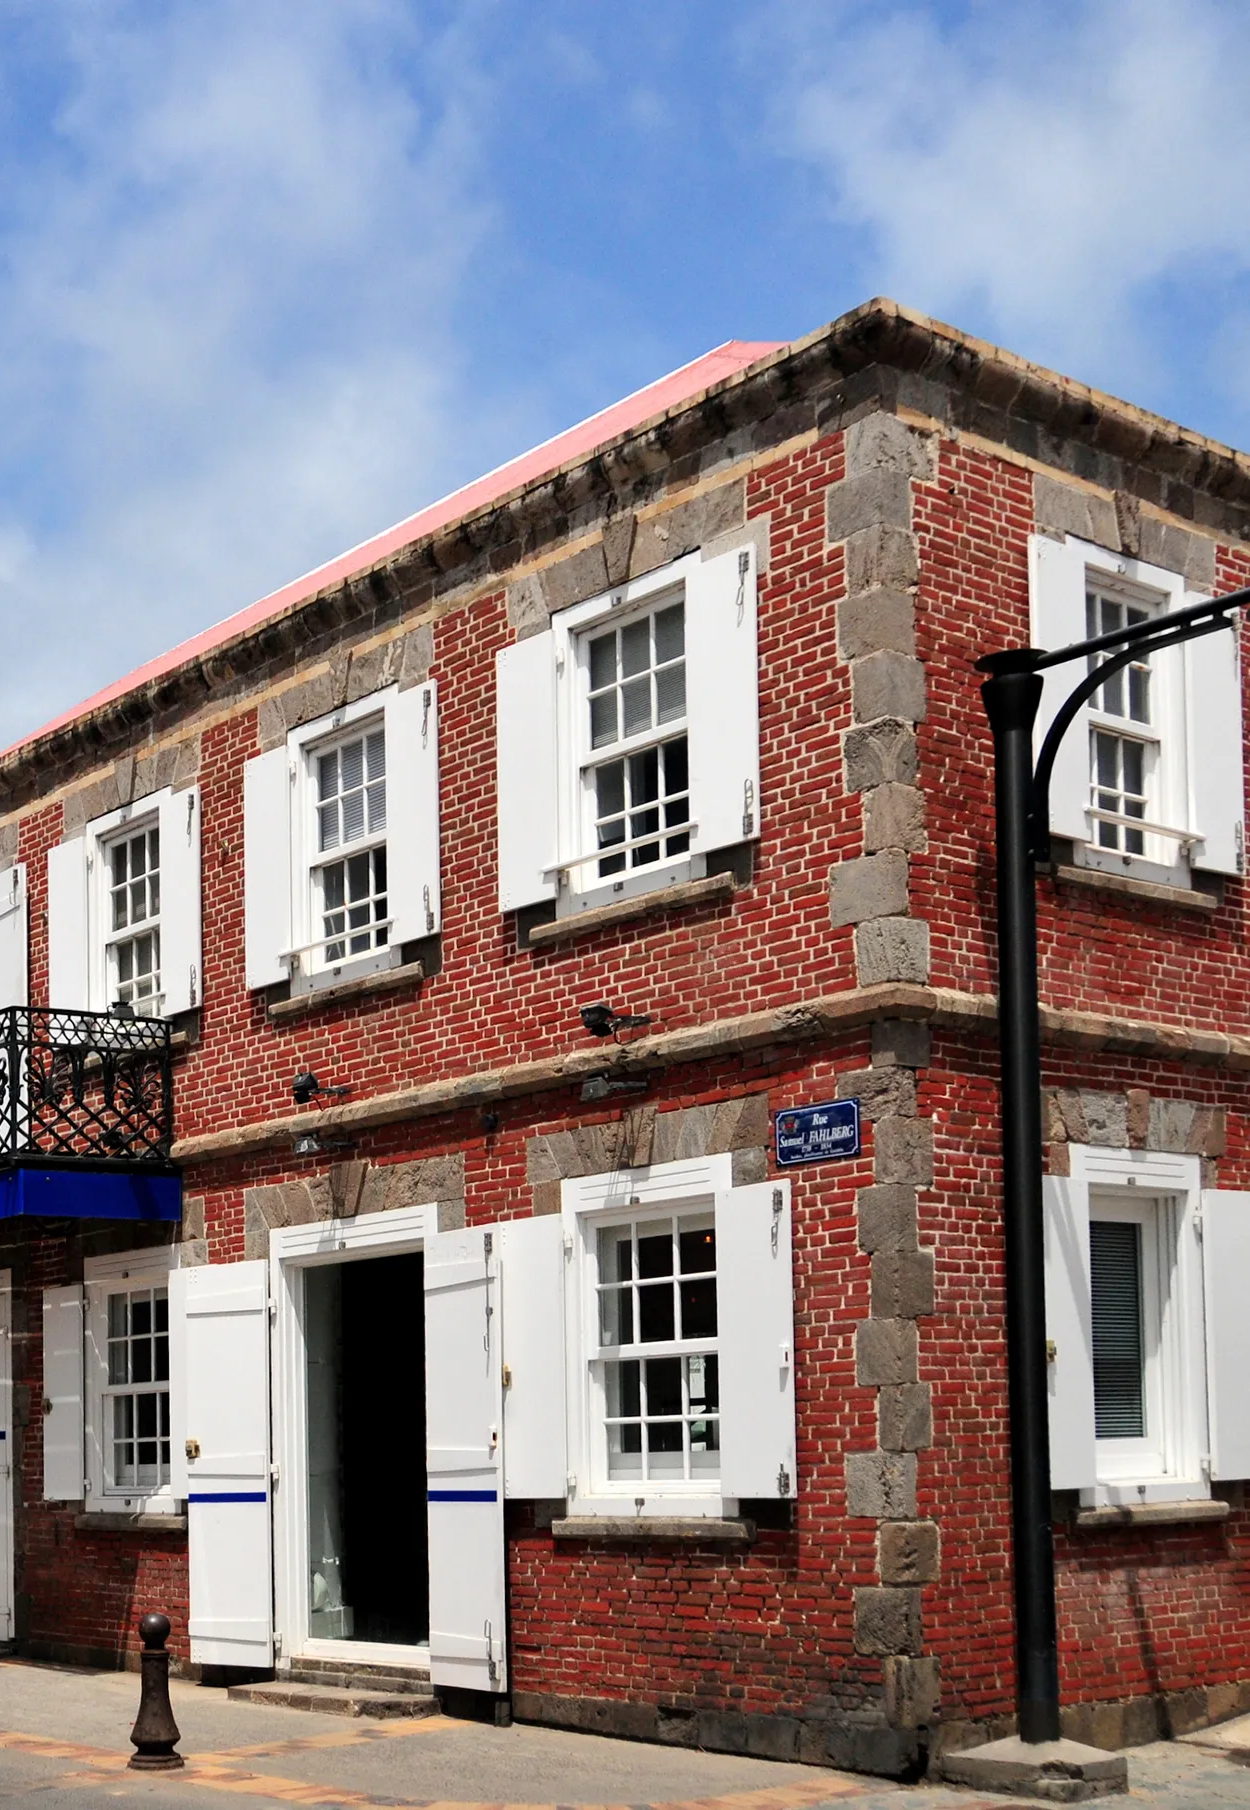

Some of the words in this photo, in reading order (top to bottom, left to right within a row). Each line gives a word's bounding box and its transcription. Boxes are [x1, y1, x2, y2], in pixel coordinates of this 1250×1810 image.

[812, 1113, 828, 1125] Rue
[780, 1132, 805, 1148] Samuel
[809, 1124, 854, 1143] FAHLBERG
